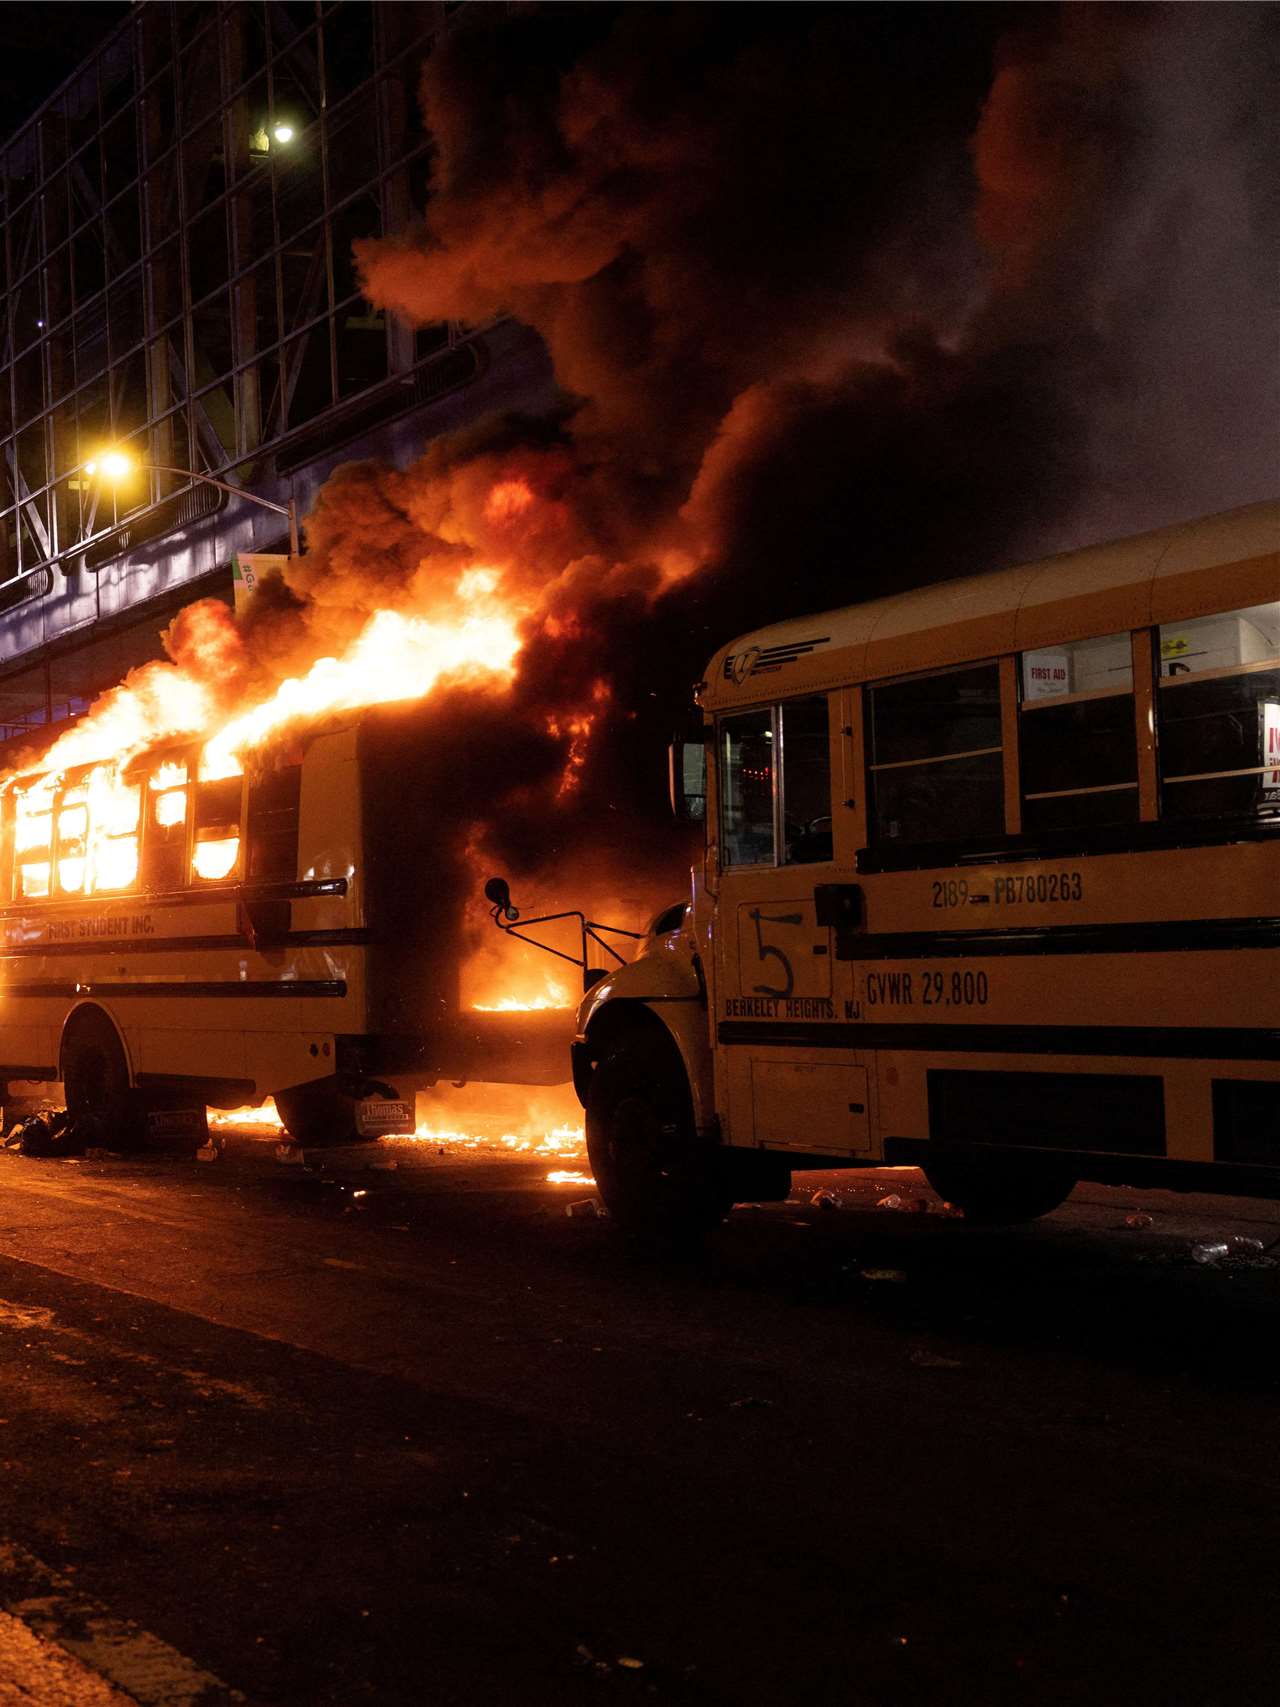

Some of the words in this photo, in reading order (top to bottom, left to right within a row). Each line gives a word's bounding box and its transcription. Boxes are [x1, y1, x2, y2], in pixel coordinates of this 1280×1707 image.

[1031, 667, 1051, 680] FIRST
[1053, 668, 1066, 681] AID
[932, 880, 969, 908] 2189
[994, 872, 1082, 905] PB780263
[48, 921, 76, 939] FIRST
[79, 917, 129, 937] STUDENT
[131, 914, 155, 934] INC.
[867, 972, 912, 1005] GVWR
[726, 1000, 779, 1017] BERKELEY
